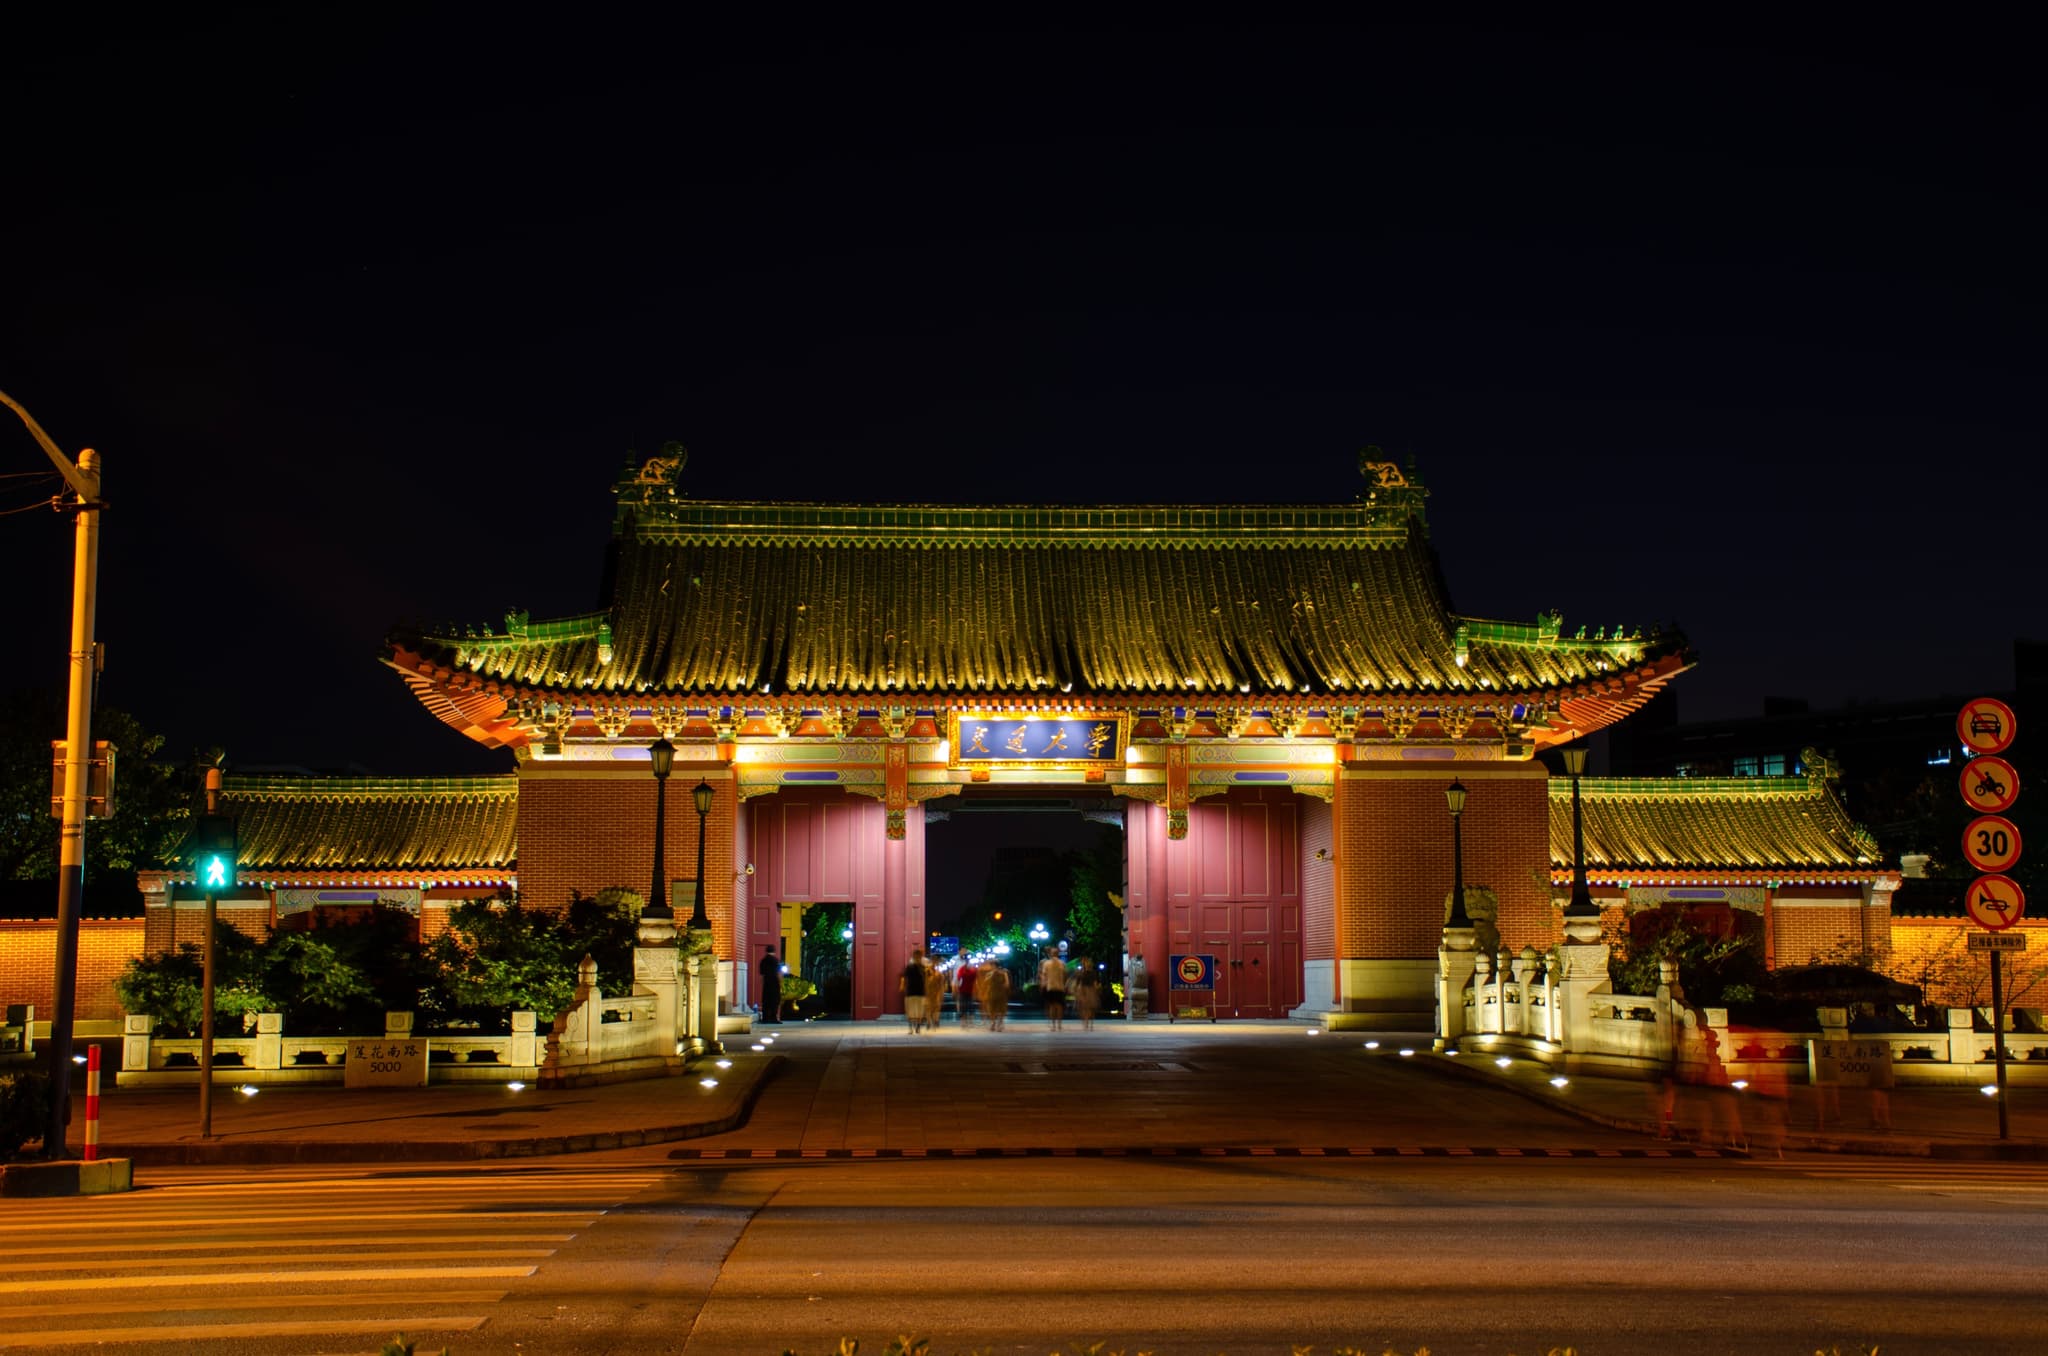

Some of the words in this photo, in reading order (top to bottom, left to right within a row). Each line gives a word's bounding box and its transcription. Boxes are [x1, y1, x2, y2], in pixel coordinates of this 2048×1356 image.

[1976, 830, 2008, 857] 30
[370, 1061, 402, 1073] 5000
[1840, 1062, 1871, 1073] 5000
